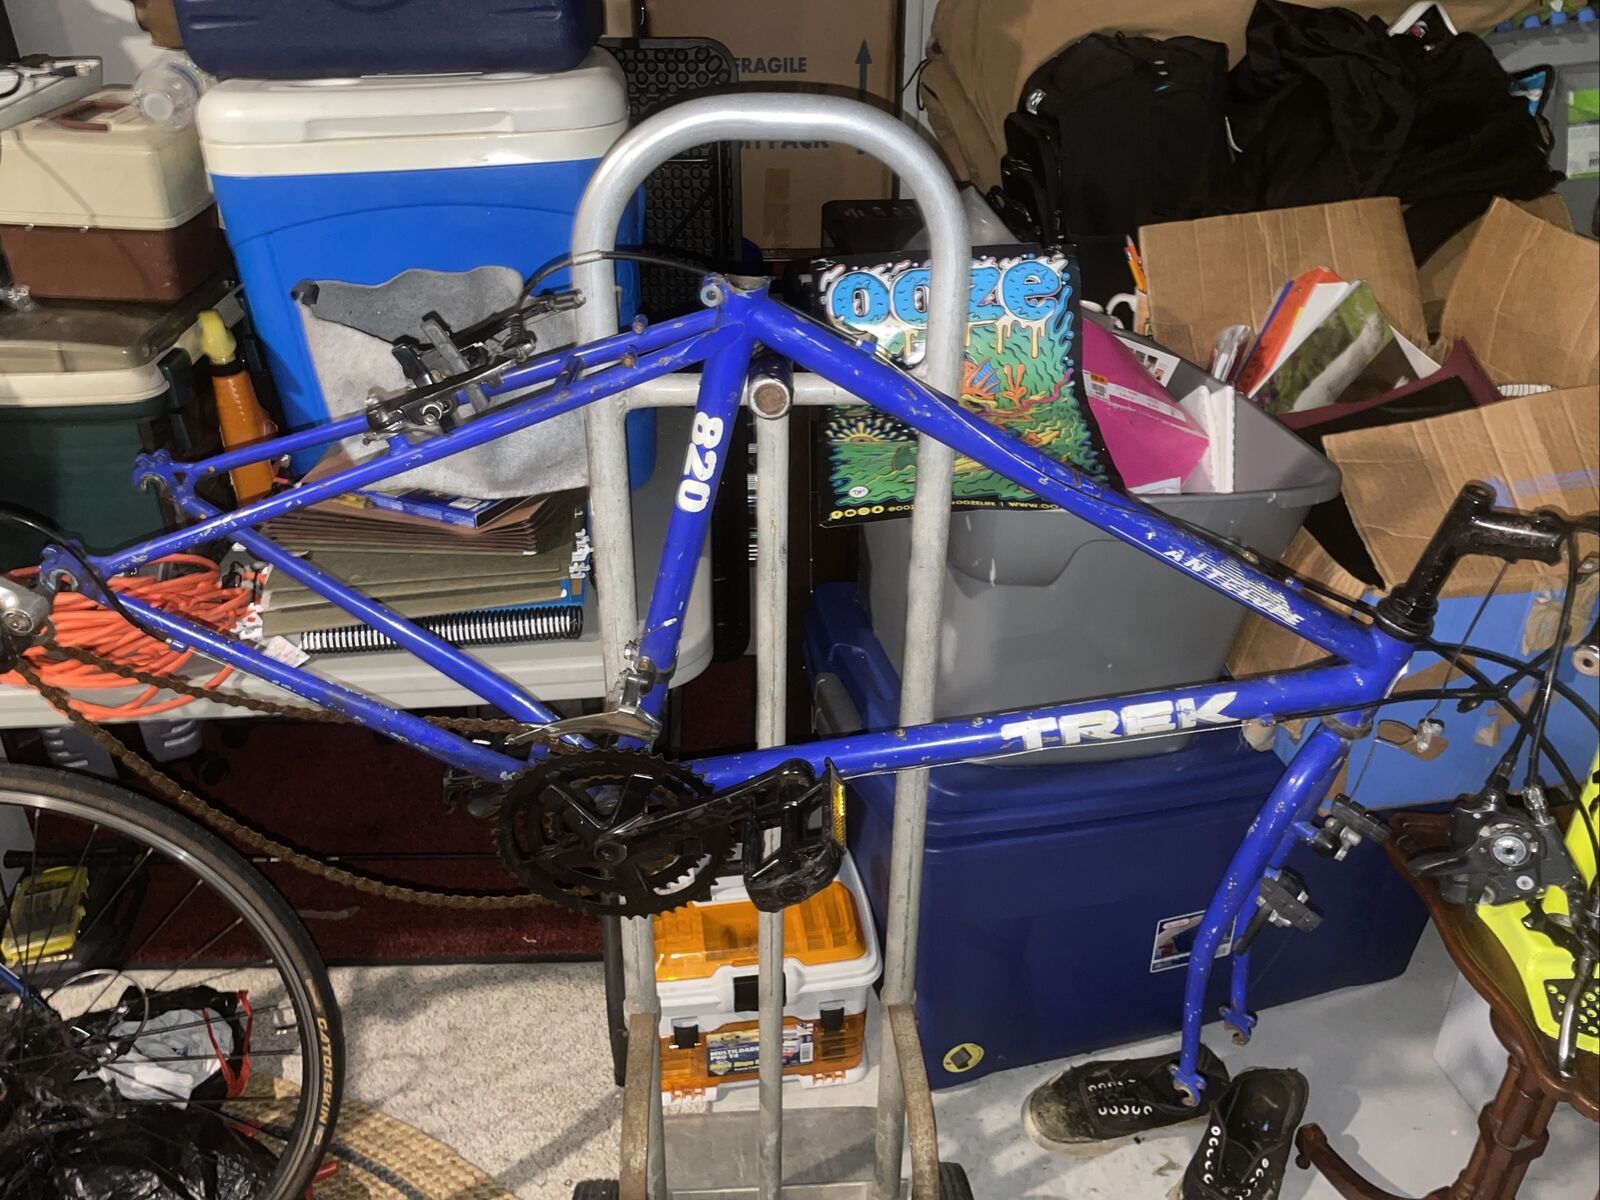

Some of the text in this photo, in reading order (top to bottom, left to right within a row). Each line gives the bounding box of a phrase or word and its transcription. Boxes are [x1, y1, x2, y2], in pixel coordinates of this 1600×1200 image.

[678, 411, 724, 512] 820
[1001, 691, 1237, 750] TREK
[317, 1017, 333, 1123] GATORSKIN
